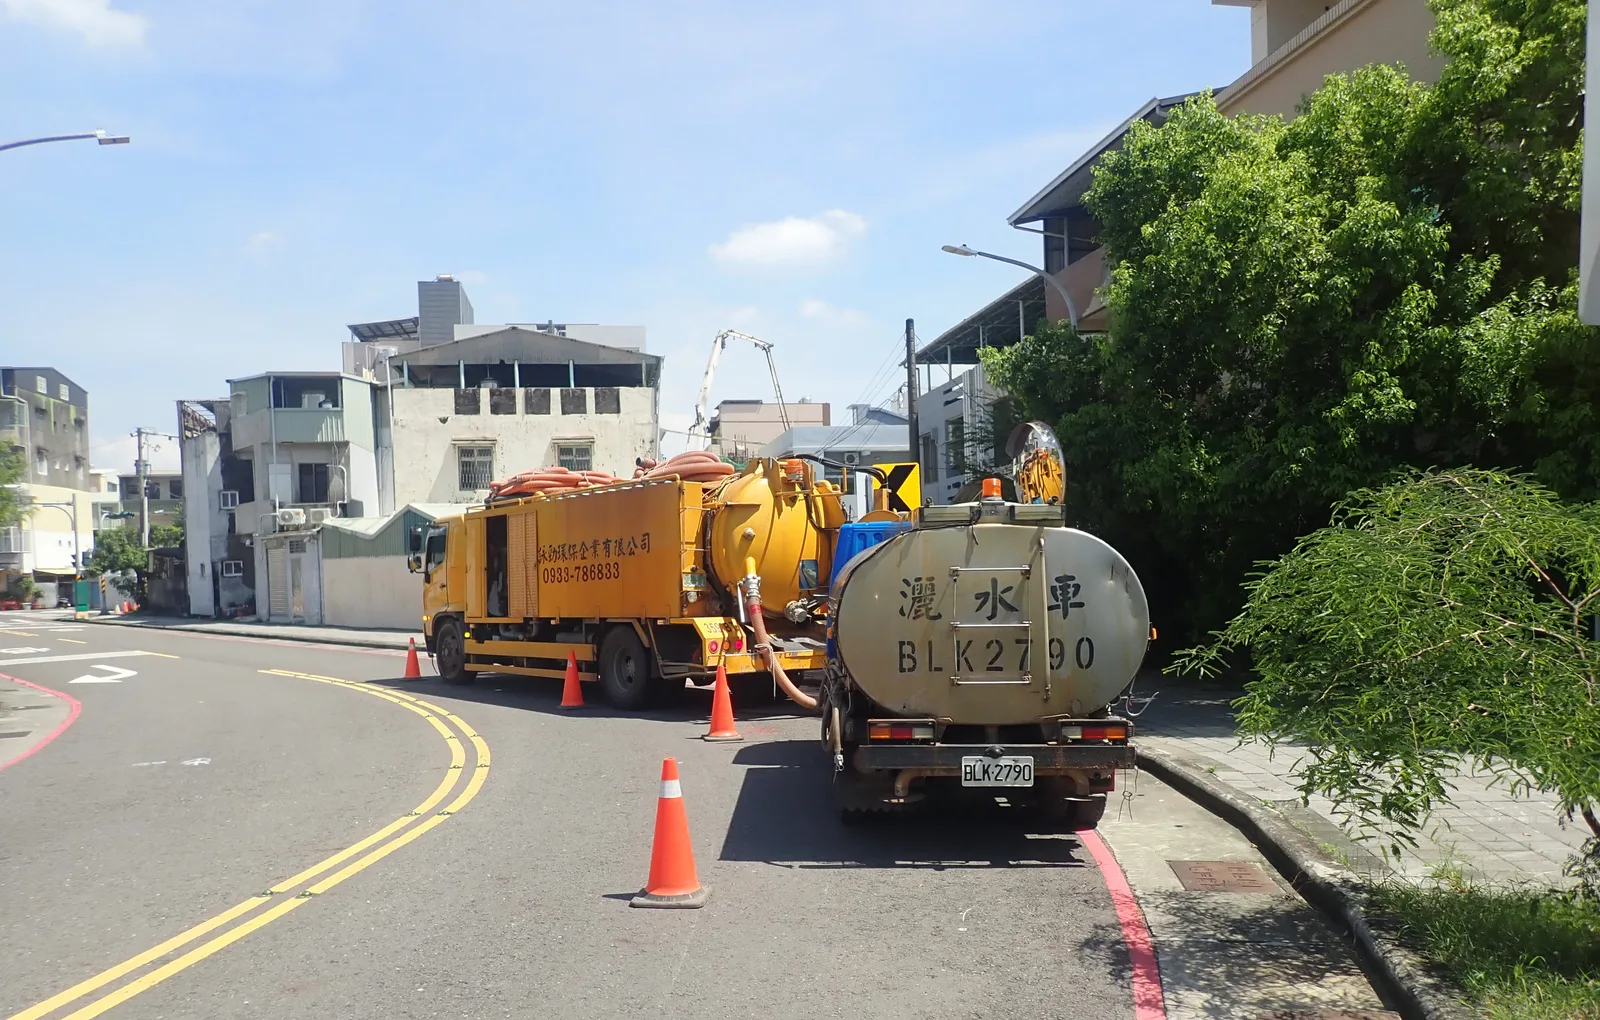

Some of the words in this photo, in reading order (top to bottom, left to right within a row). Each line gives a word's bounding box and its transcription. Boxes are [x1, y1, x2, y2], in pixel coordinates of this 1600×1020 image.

[542, 561, 620, 584] 0933-786833
[898, 573, 1086, 621] 灑水車
[898, 636, 1095, 673] BLK2790
[963, 763, 1032, 782] BLK-2790
